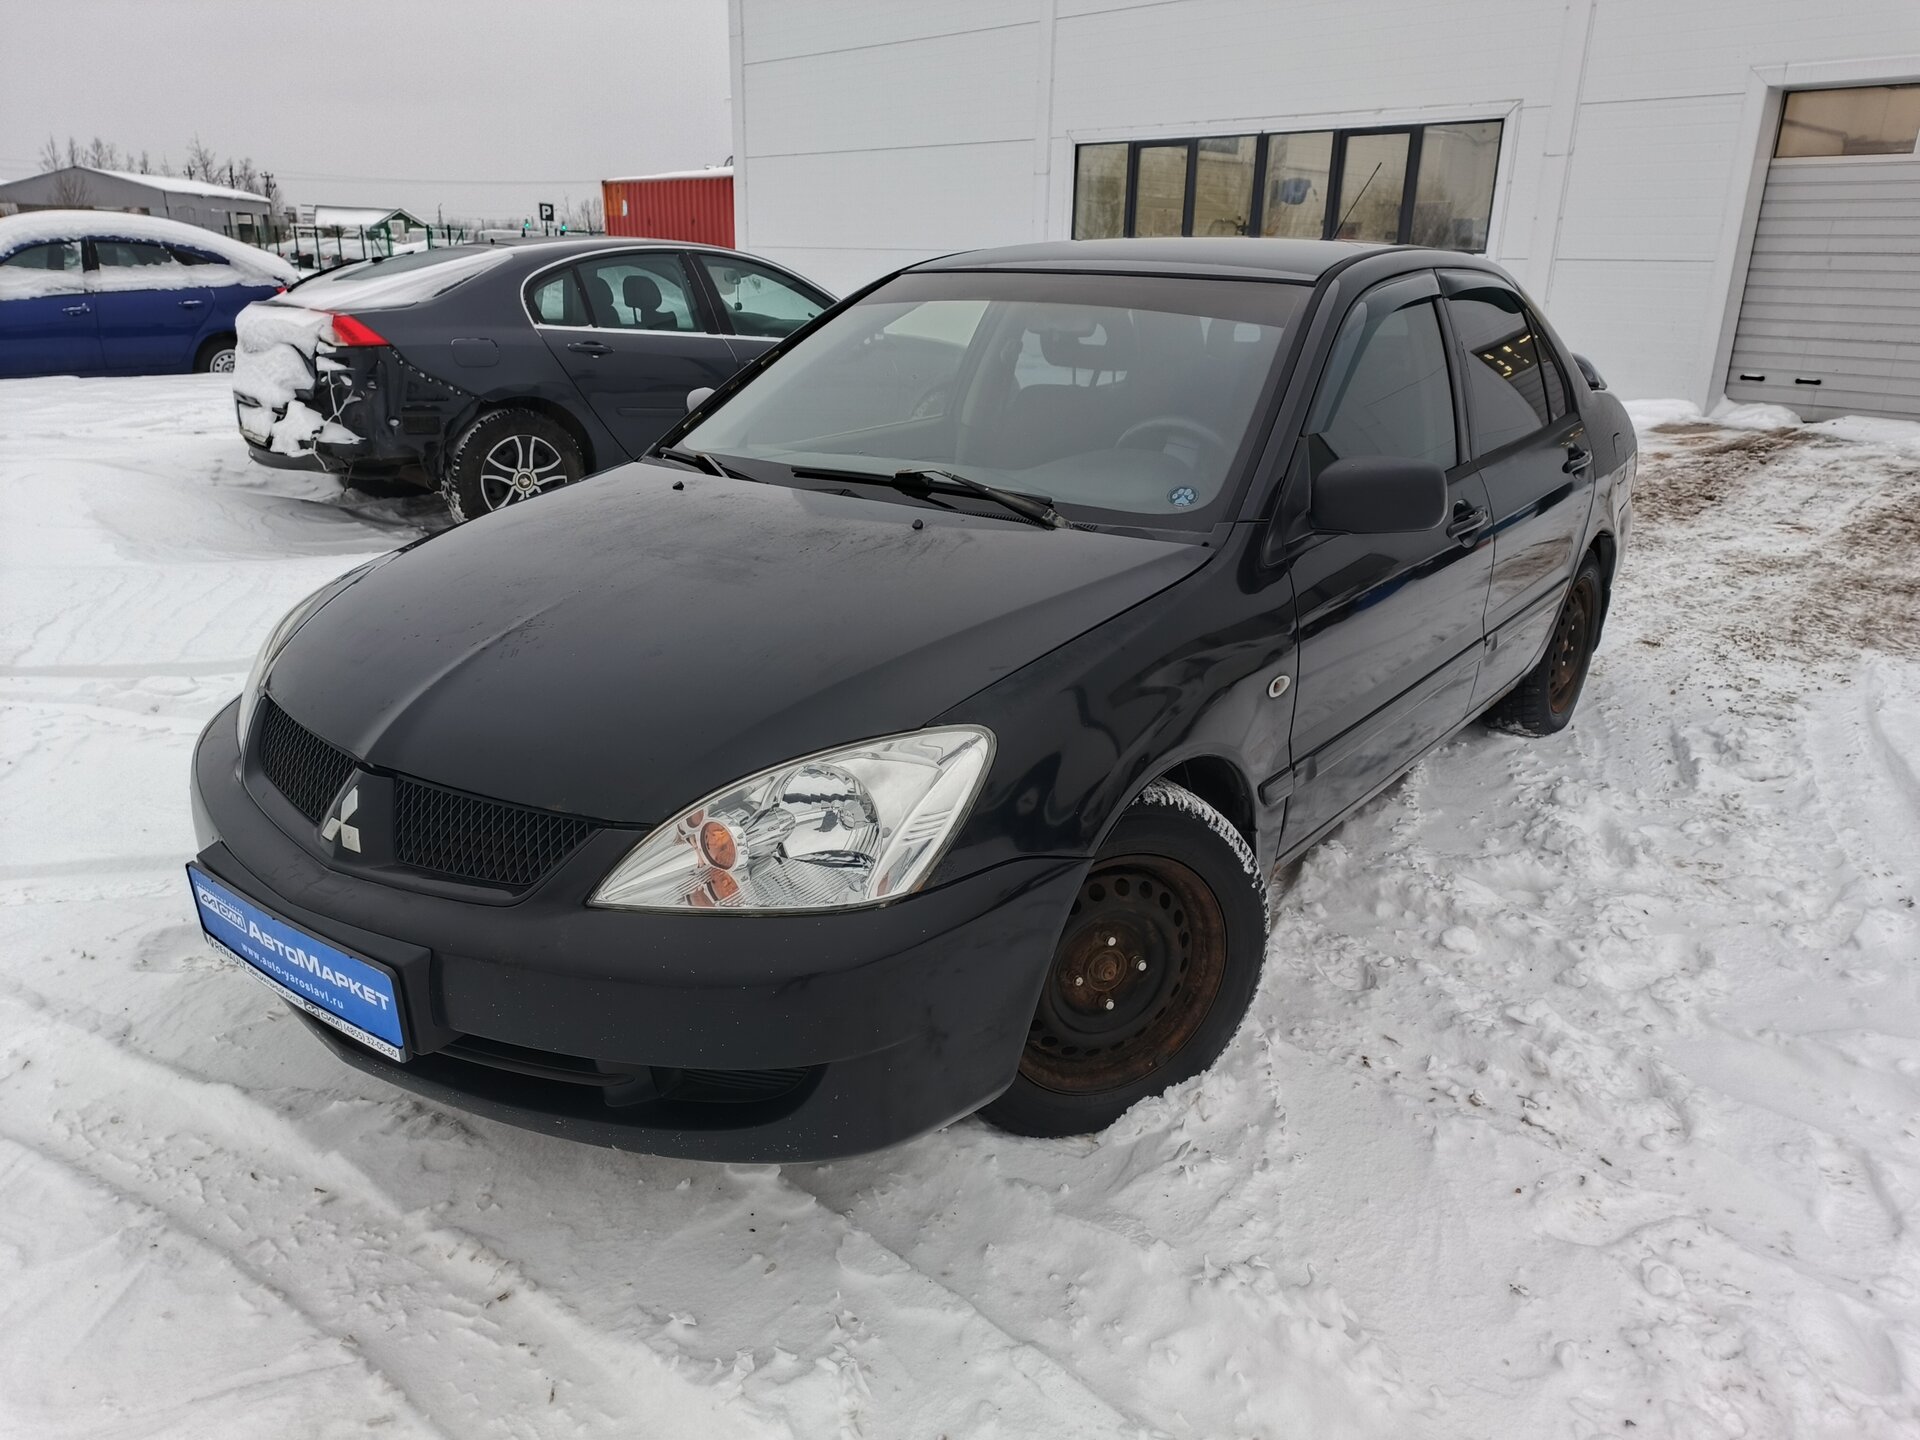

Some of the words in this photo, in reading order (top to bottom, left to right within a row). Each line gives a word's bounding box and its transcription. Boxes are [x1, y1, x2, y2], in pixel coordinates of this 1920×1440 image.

[541, 204, 552, 220] P
[213, 941, 247, 970] RENAULT
[241, 942, 344, 1010] www.auto-yaroslavl.ru
